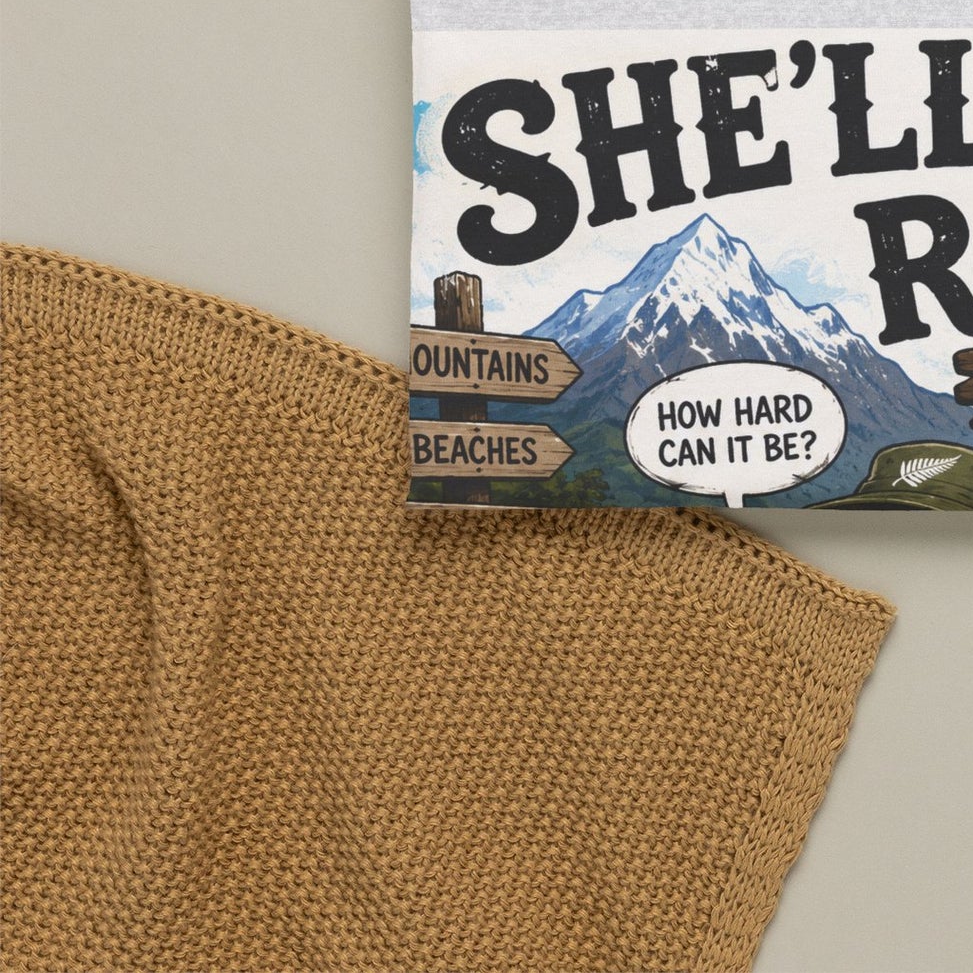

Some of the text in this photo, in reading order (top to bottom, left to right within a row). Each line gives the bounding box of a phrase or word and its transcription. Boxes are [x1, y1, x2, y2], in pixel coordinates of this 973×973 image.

[412, 343, 549, 384] OUNTAINS
[658, 393, 813, 432] HOW HARD
[412, 433, 538, 465] BEACHES
[658, 430, 817, 468] CAN IT BE?
